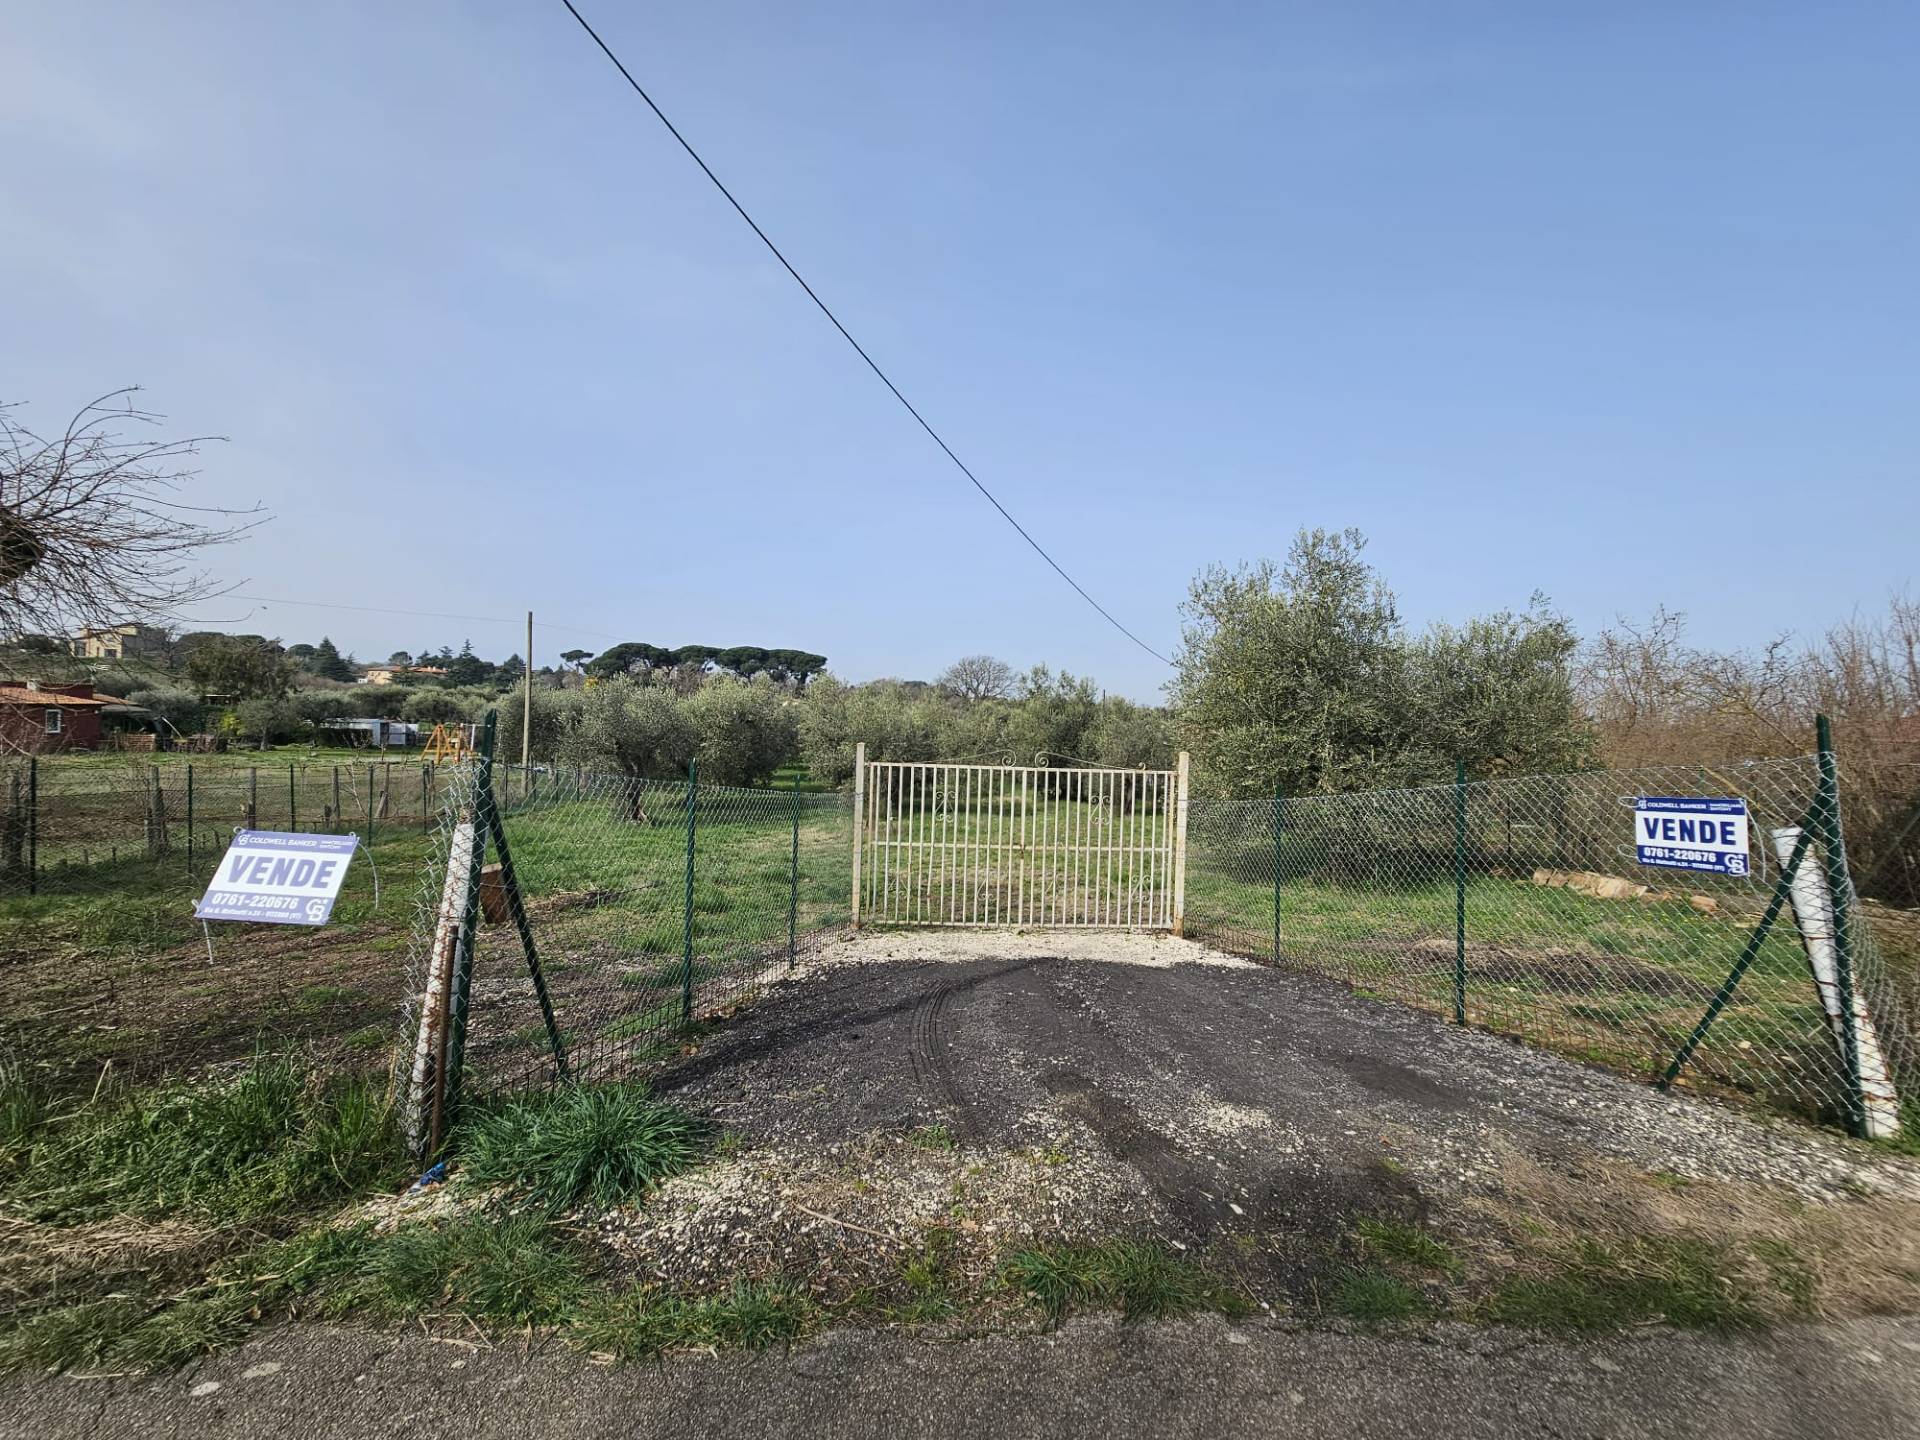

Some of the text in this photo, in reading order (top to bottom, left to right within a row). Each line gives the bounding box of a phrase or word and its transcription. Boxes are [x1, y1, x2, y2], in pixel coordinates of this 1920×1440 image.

[1643, 817, 1737, 846] VENDE
[249, 837, 287, 846] COLDWELL
[287, 839, 317, 847] BANKER
[1643, 847, 1717, 862] 0761-220676
[228, 855, 337, 889] VENDE
[212, 893, 299, 910] 0761-220676
